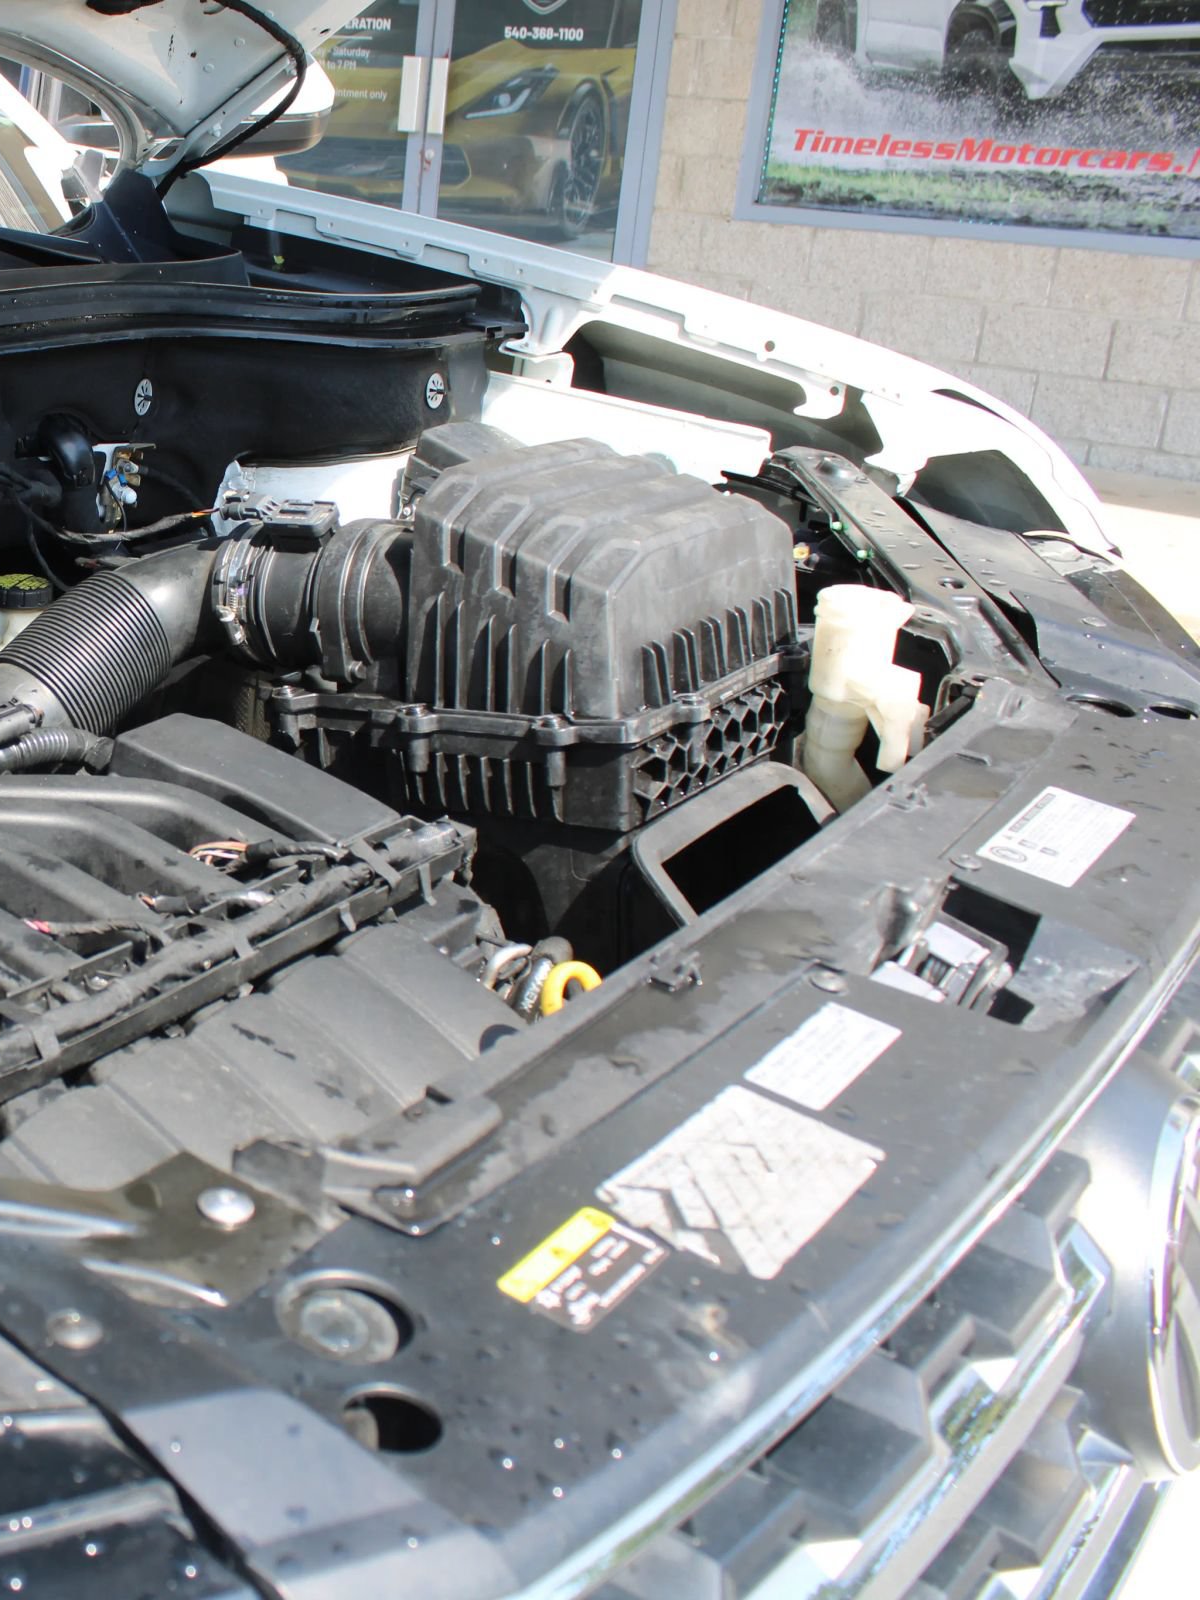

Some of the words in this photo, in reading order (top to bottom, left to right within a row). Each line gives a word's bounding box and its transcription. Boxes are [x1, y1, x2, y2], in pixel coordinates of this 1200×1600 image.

[345, 17, 392, 31] ERATION
[332, 46, 371, 59] Saturday
[327, 60, 336, 70] to
[343, 60, 357, 71] PM
[335, 88, 368, 98] intment
[369, 90, 388, 102] only
